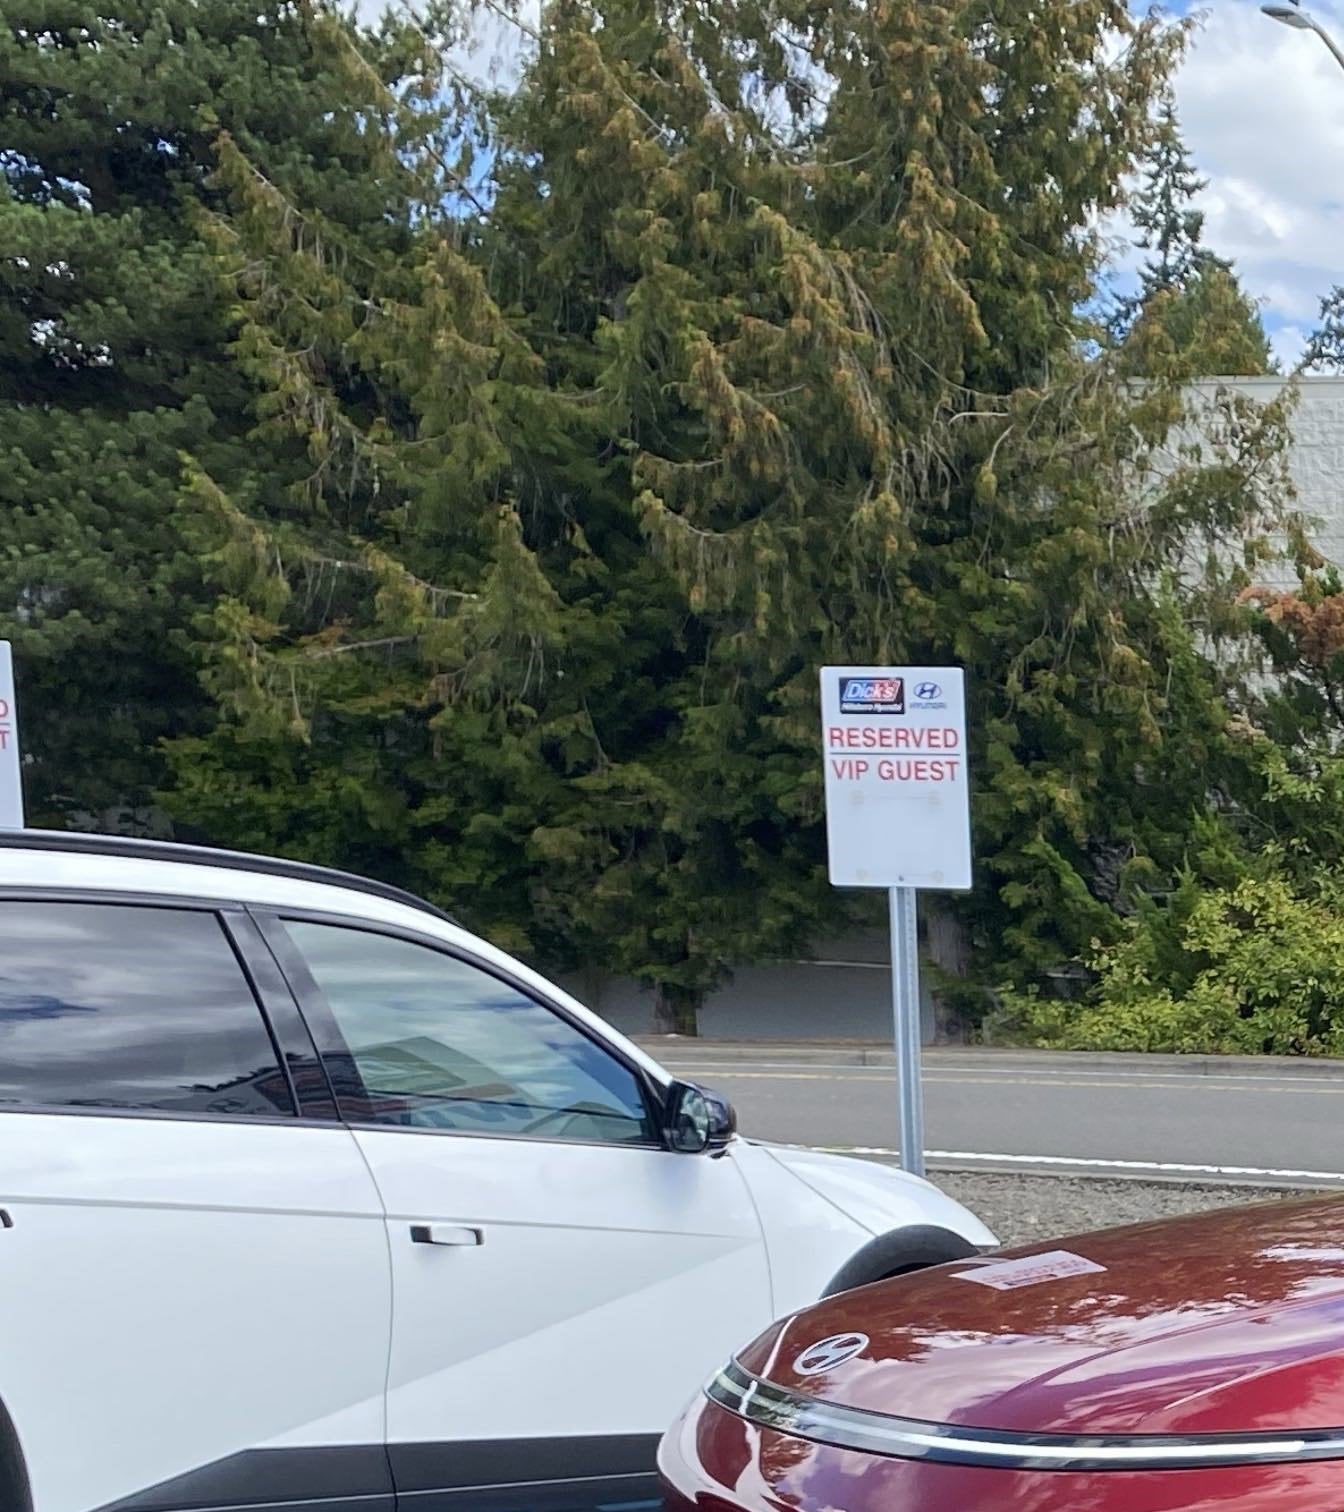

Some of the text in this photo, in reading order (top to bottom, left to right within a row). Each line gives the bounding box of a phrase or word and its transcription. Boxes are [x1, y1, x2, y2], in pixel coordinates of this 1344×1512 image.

[829, 727, 959, 748] RESERVED
[831, 760, 960, 781] VIP GUEST
